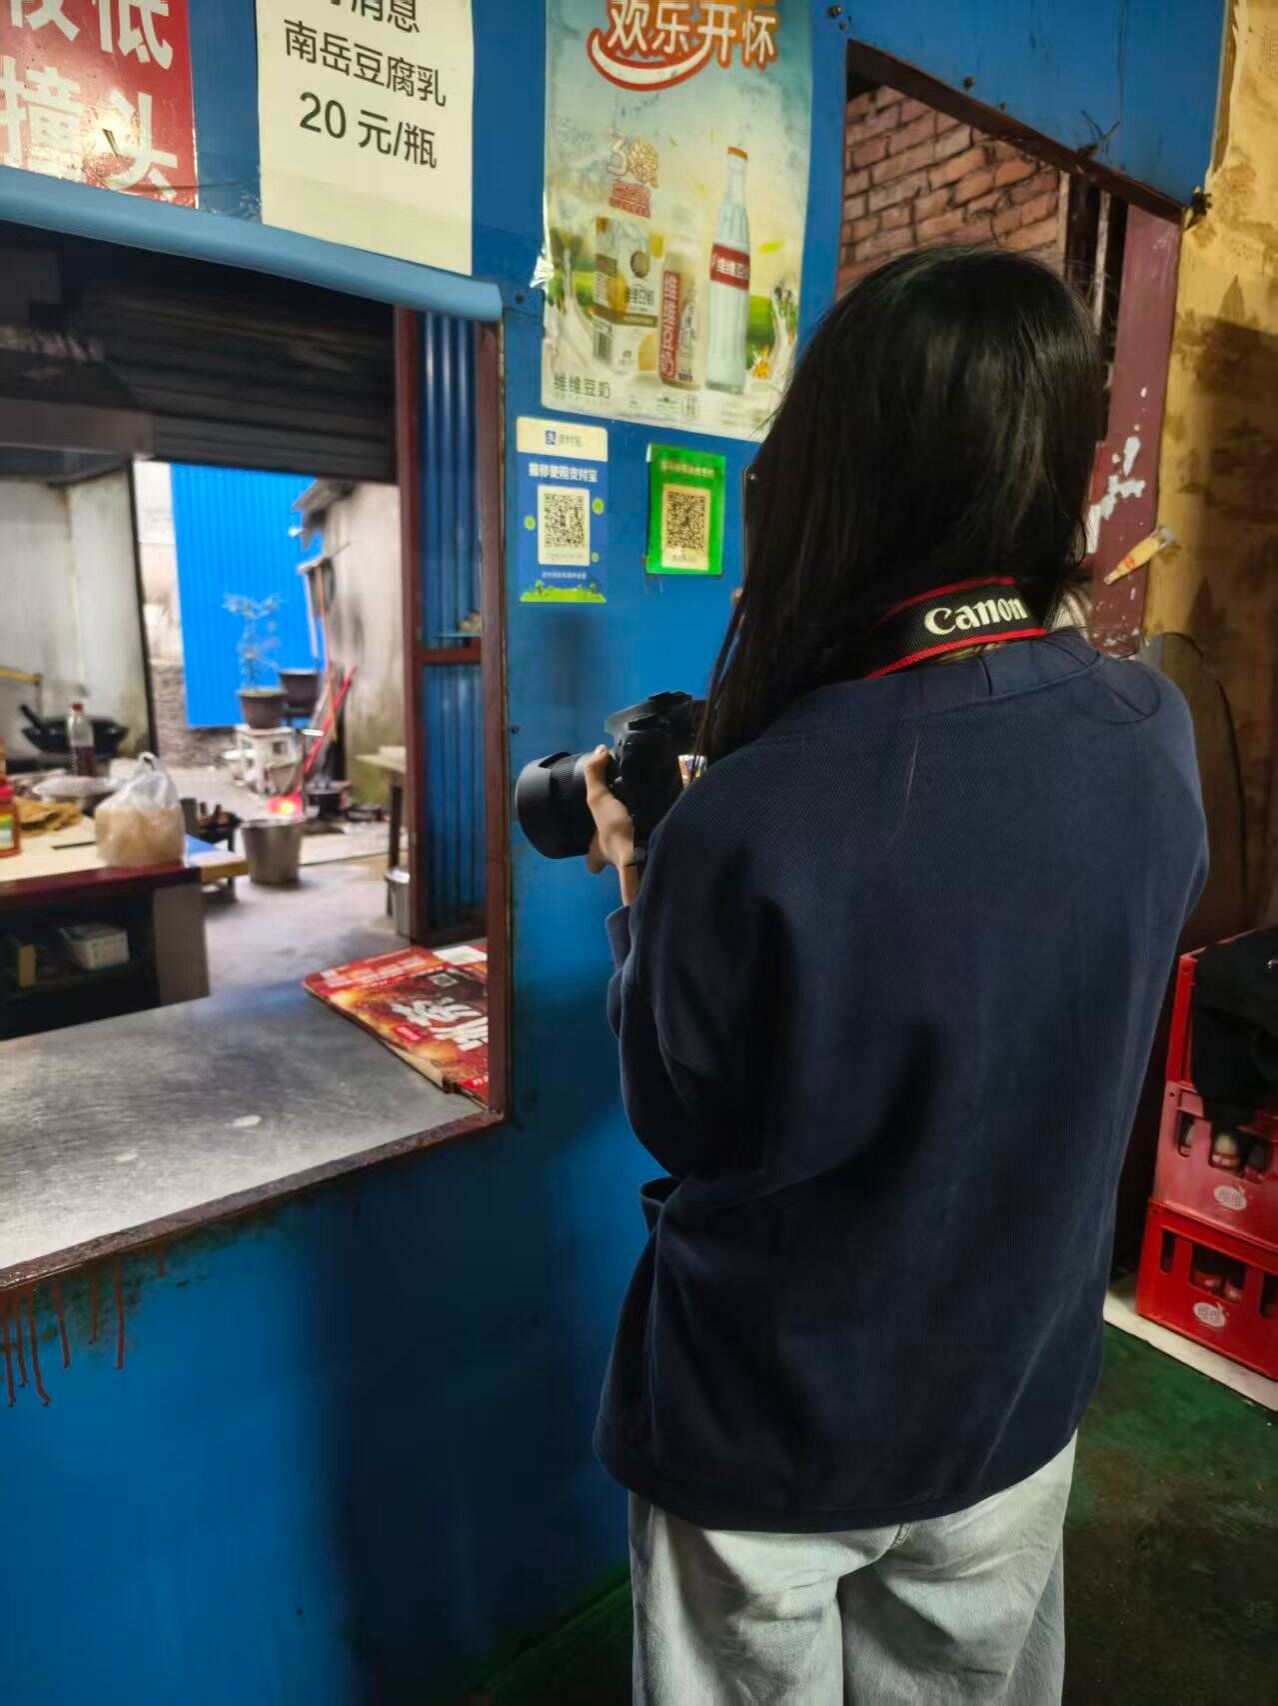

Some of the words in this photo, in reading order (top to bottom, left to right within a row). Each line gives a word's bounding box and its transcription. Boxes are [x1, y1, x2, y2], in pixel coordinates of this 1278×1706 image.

[284, 19, 447, 107] 南岳豆腐乳
[608, 0, 776, 63] 欢乐开怀
[0, 55, 178, 203] 撞头
[300, 92, 346, 139] 20
[358, 109, 437, 169] 元/瓶
[924, 598, 1028, 635] Canon
